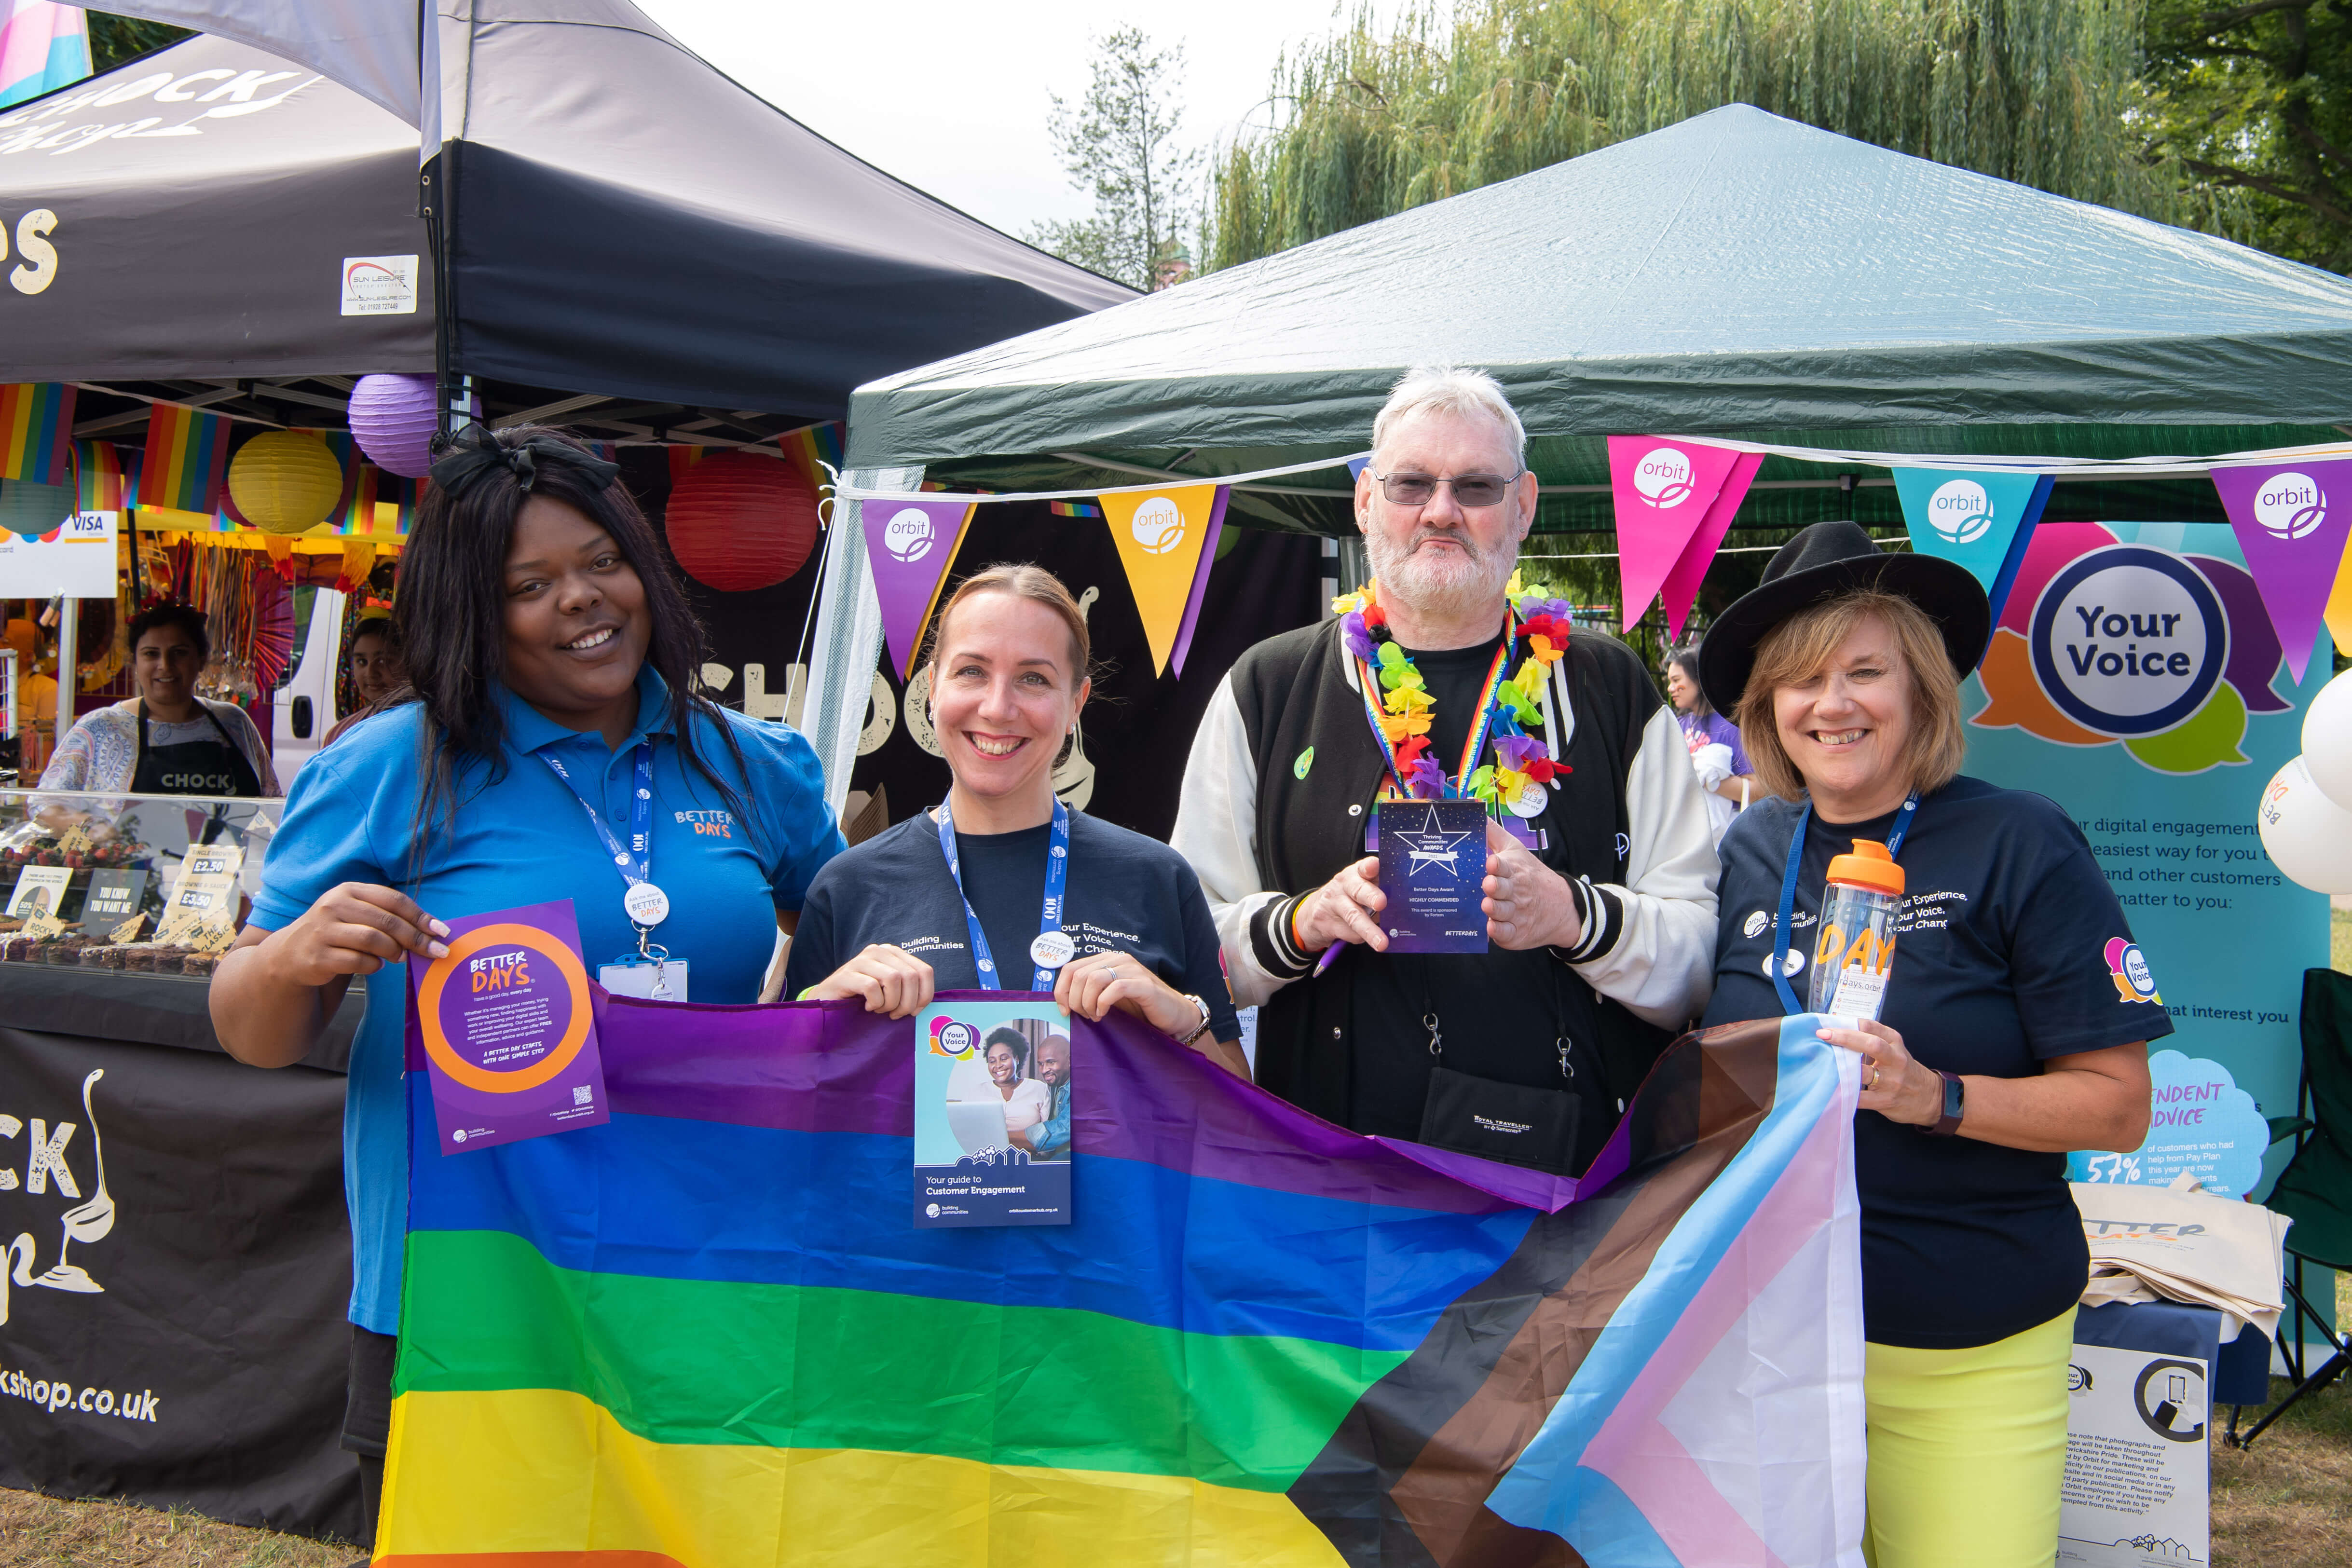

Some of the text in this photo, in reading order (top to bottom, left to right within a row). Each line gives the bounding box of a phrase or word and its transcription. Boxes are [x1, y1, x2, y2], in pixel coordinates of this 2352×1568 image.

[1643, 462, 1685, 480] orbit
[1937, 493, 1982, 512] orbit
[2262, 487, 2312, 506] orbit
[73, 516, 103, 531] VISA
[1138, 509, 1174, 526] orbit
[891, 519, 926, 536] orbit
[2076, 605, 2181, 639] Your
[2066, 644, 2191, 677] Voice
[1480, 712, 1489, 727] and
[1492, 659, 1507, 683] Service
[1378, 728, 1390, 743] and
[161, 774, 230, 788] CHOCK
[674, 810, 736, 826] BETTER
[694, 821, 731, 839] DAYS
[2094, 818, 2260, 837] digital engagement
[632, 834, 644, 852] 100
[2092, 844, 2257, 862] easiest way for you
[194, 860, 224, 872] £2.50
[2102, 868, 2281, 886] and other customers
[99, 887, 131, 900] YOU KNOW
[181, 893, 211, 907] £3.50
[1912, 891, 1969, 905] Experience,
[18, 901, 34, 910] 50%
[90, 900, 133, 914] YOU WANT ME
[631, 897, 664, 912] BETTER
[1044, 898, 1057, 919] 100
[2173, 894, 2191, 907] to
[2195, 896, 2232, 911] you:
[640, 906, 660, 918] DAYS
[1915, 907, 1946, 918] Voice,
[30, 923, 54, 935] ROCKY
[1747, 916, 1764, 927] orbit
[201, 924, 230, 952] CLASSIC
[203, 924, 219, 940] THE
[1061, 922, 1141, 943] our Experience,
[901, 936, 940, 949] building
[1083, 933, 1114, 947] Voice,
[1035, 942, 1069, 956] BETTER
[1038, 950, 1060, 961] DAYS
[1817, 924, 1897, 976] DAY
[470, 951, 527, 973] BETTER
[472, 963, 530, 993] DAYS
[489, 992, 501, 1001] good
[2191, 1005, 2289, 1024] interest you
[489, 1047, 509, 1056] BETTER
[522, 1041, 543, 1050] STARTS
[483, 1057, 497, 1065] WITH
[511, 1050, 530, 1060] SIMPLE
[1474, 1115, 1531, 1129] ROYAL TRAVELLER
[2150, 1106, 2207, 1129] DVICE
[2157, 1143, 2198, 1152] customers
[2218, 1140, 2234, 1149] had
[2147, 1152, 2220, 1164] help from Pay Plan
[2087, 1152, 2141, 1184] 57%
[2148, 1165, 2162, 1173] this
[2164, 1165, 2180, 1175] year
[926, 1176, 946, 1185] Your
[947, 1176, 971, 1186] guide
[926, 1185, 1026, 1197] Customer Engagement
[2108, 1438, 2151, 1449] photographs
[2122, 1454, 2142, 1462] These
[2124, 1446, 2161, 1458] throughout
[2105, 1467, 2147, 1479] publications,
[2111, 1460, 2145, 1471] marketing
[2104, 1474, 2145, 1486] social media
[2083, 1486, 2115, 1496] employee
[2090, 1479, 2174, 1499] publication. Please notify
